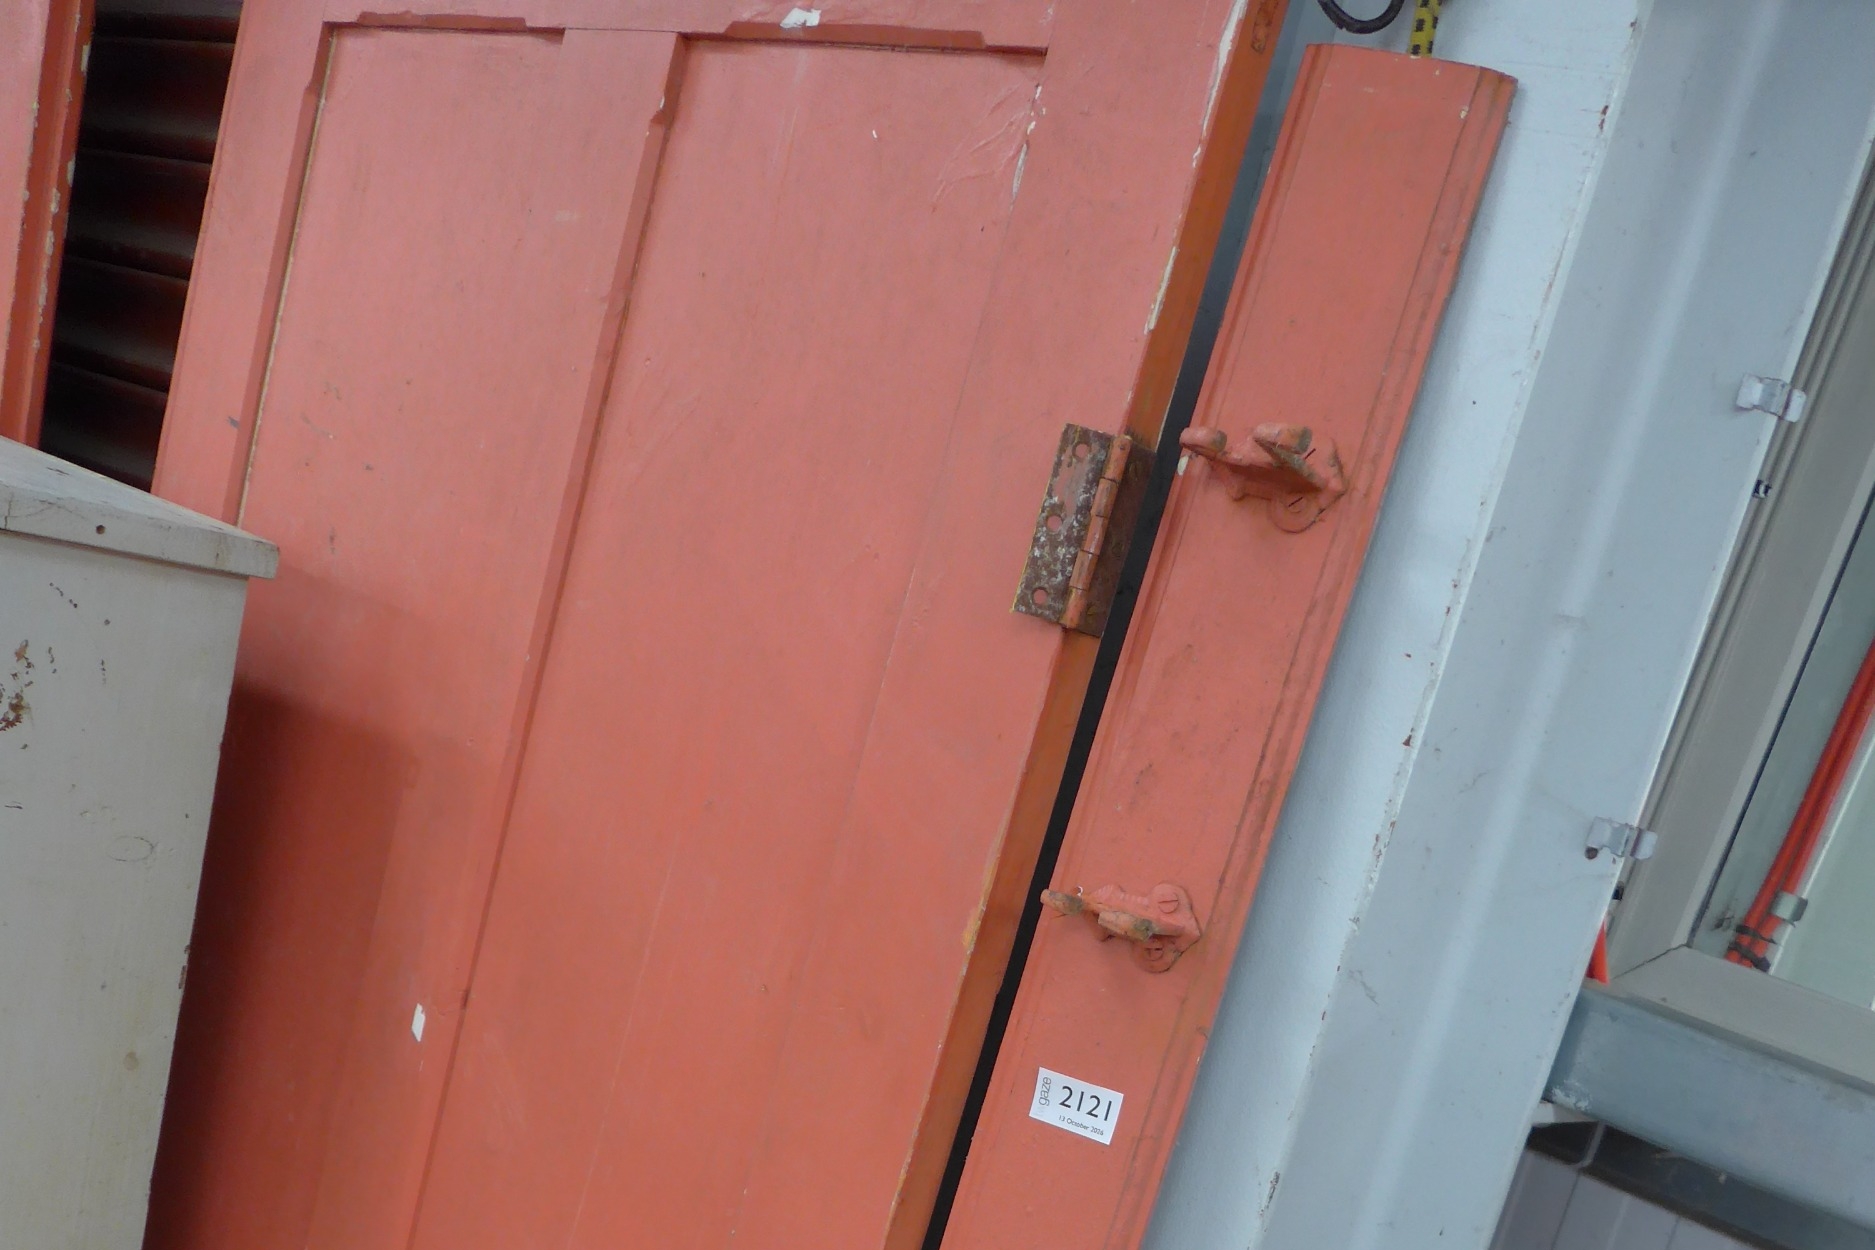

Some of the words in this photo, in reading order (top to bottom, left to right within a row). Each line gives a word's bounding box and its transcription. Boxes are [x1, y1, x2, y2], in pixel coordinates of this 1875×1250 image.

[1038, 1077, 1052, 1106] gaze
[1058, 1086, 1112, 1121] 2121
[1066, 1118, 1089, 1130] October
